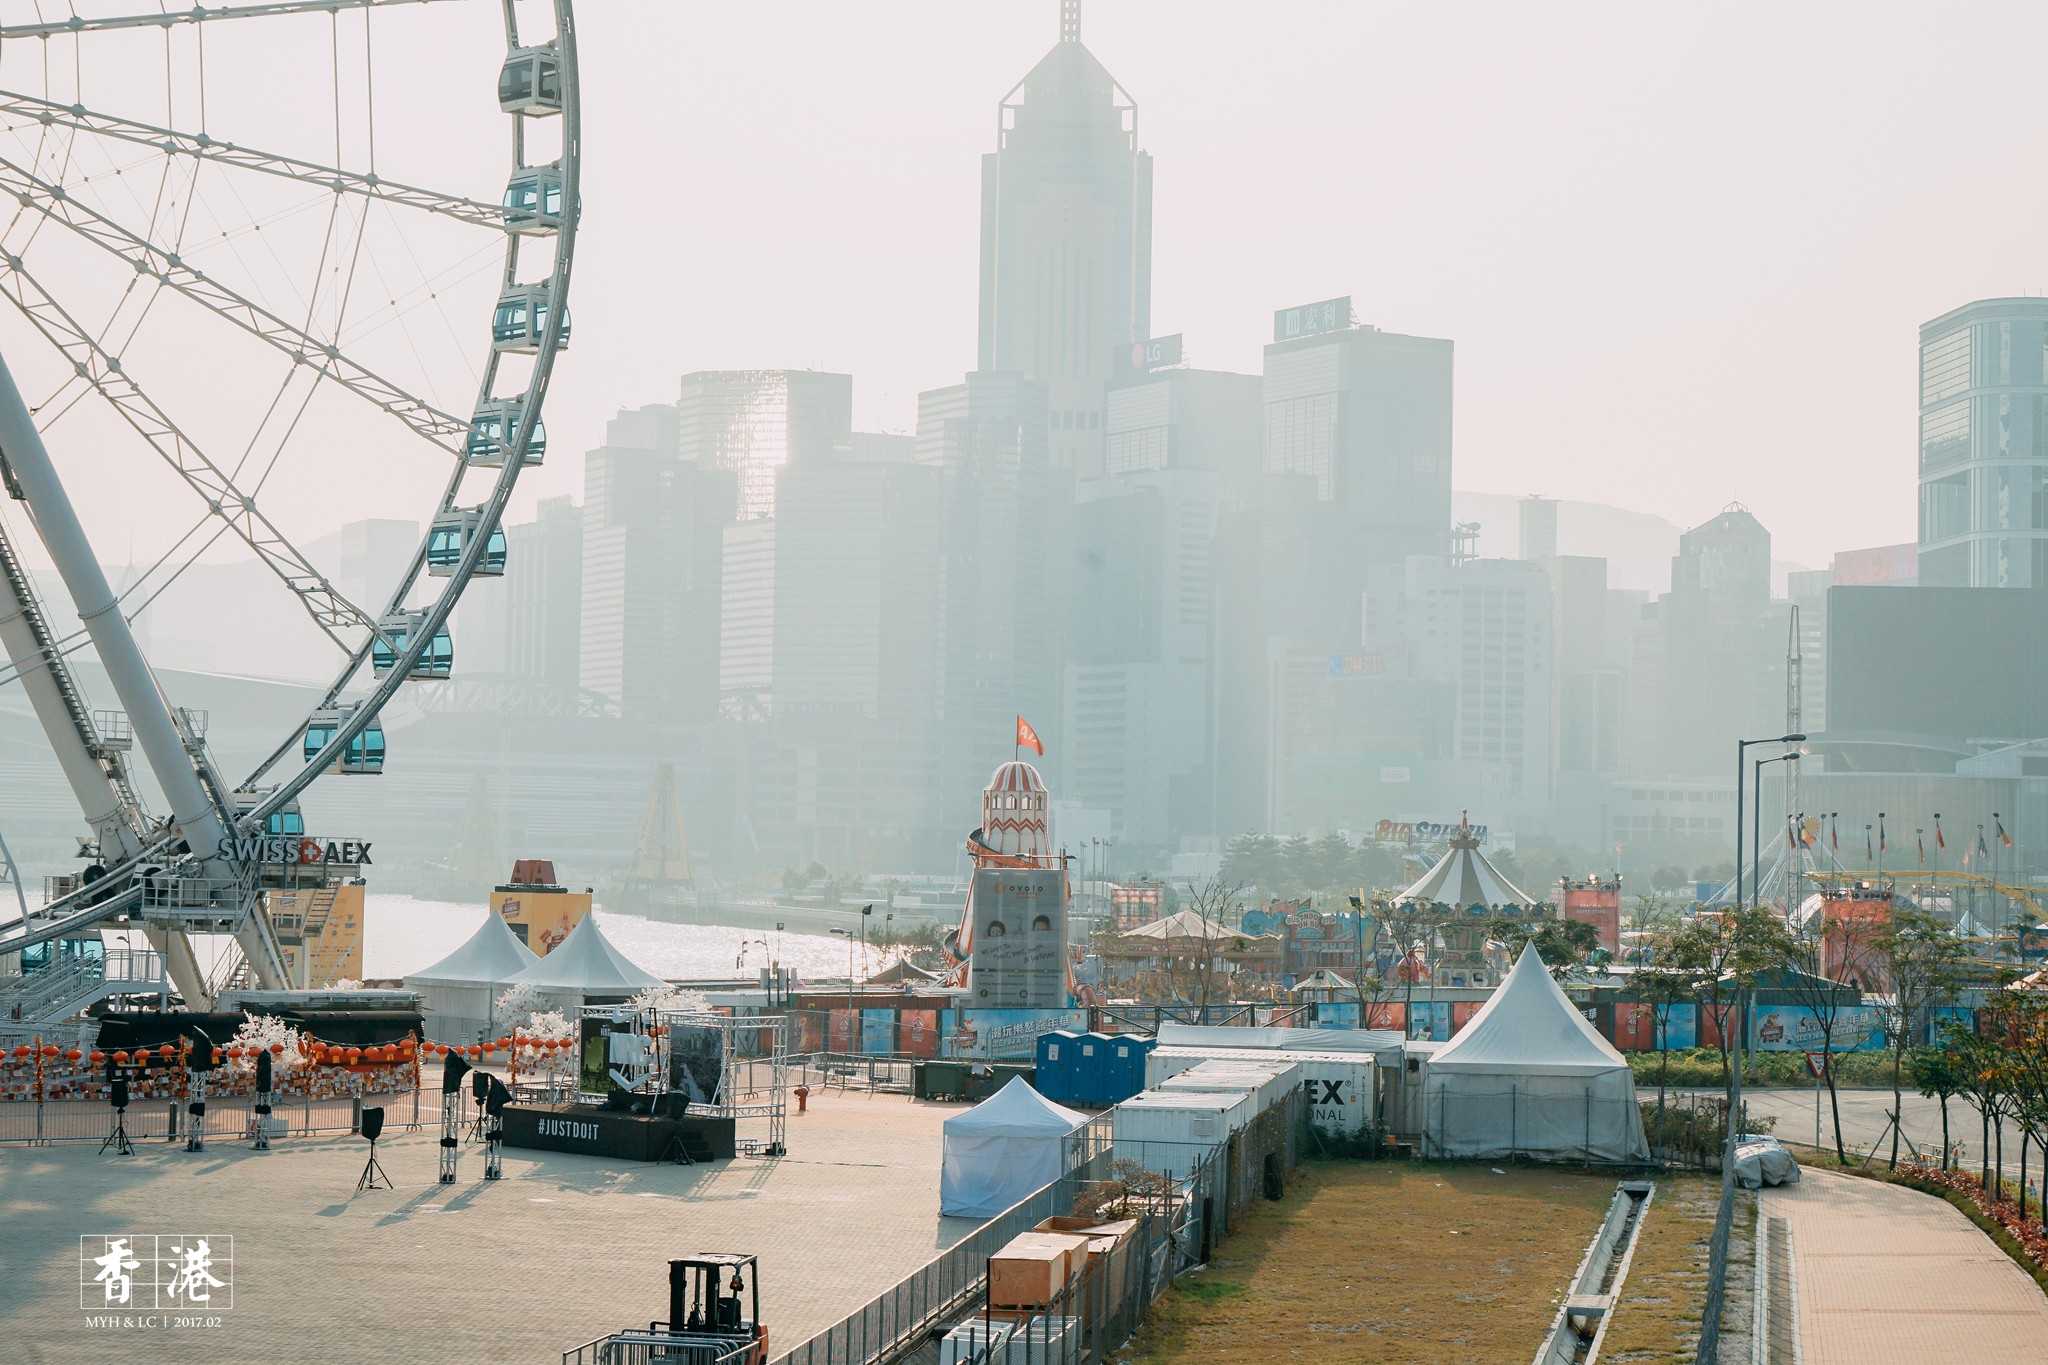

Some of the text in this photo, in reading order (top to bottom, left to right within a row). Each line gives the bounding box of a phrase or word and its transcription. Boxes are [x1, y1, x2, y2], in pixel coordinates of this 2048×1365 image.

[1304, 302, 1336, 330] 宏利
[1146, 344, 1161, 362] LG
[1376, 819, 1410, 841] BIG
[218, 838, 373, 865] SWISS AEX
[538, 1118, 599, 1141] #JUSTDOIT
